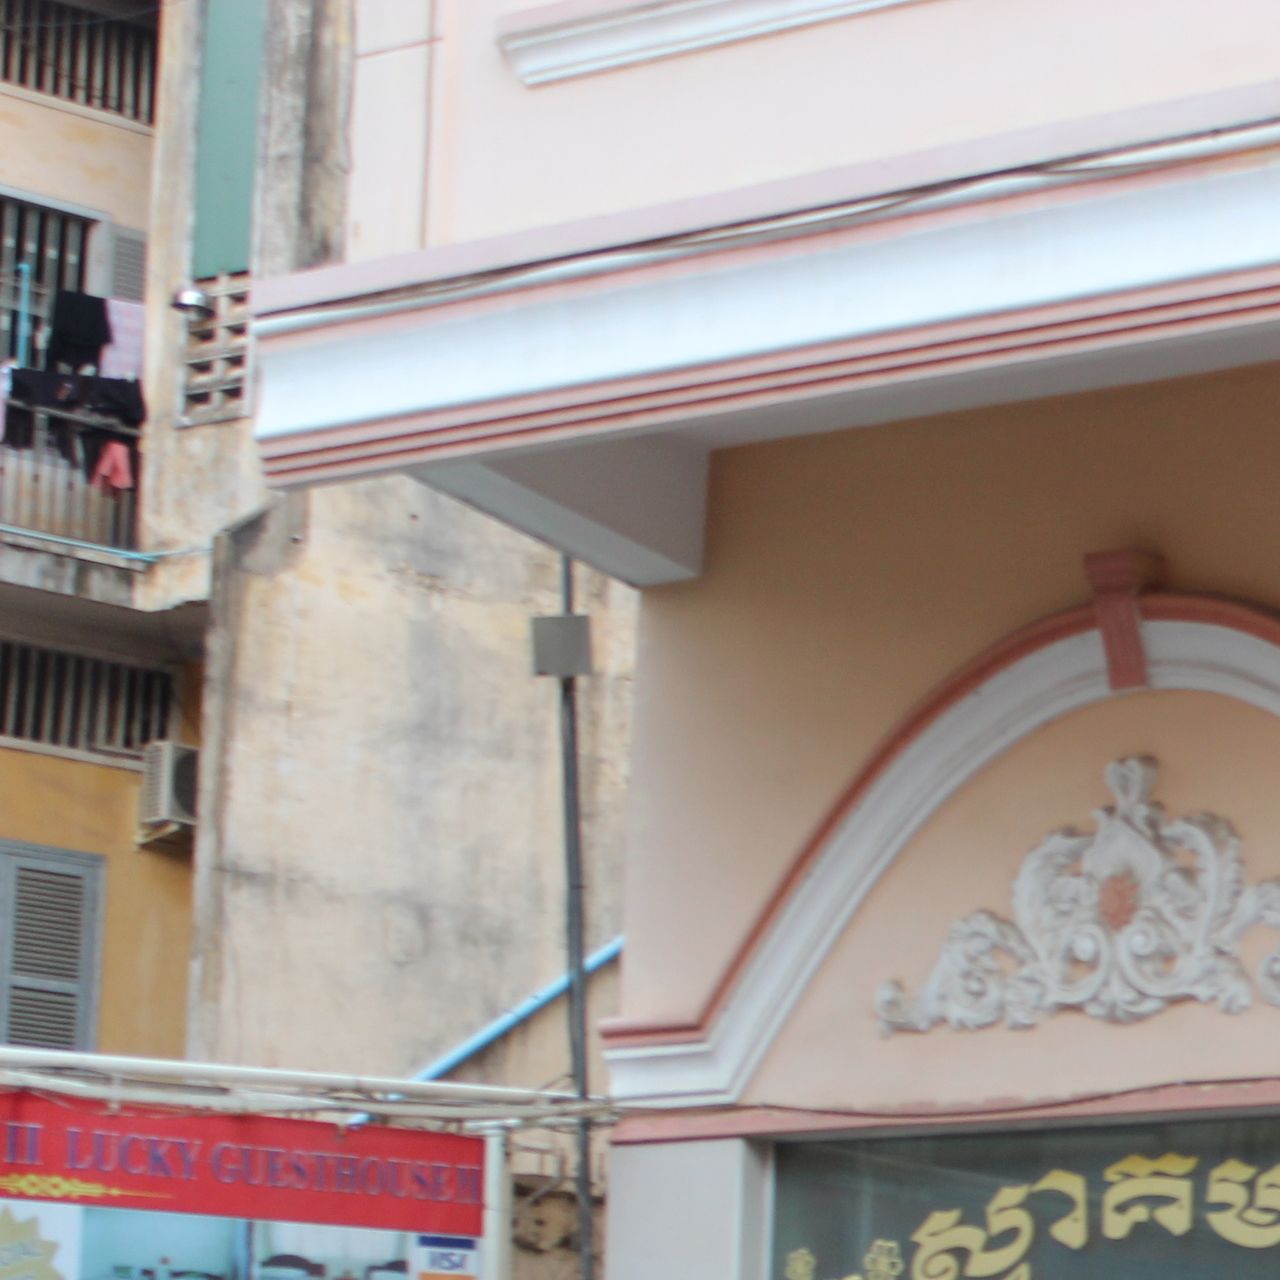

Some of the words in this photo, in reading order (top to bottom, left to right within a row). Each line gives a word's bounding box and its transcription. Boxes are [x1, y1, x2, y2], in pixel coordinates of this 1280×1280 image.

[4, 1121, 44, 1166] II
[65, 1126, 204, 1181] LUCKY
[210, 1141, 454, 1202] GUESTHOUSE
